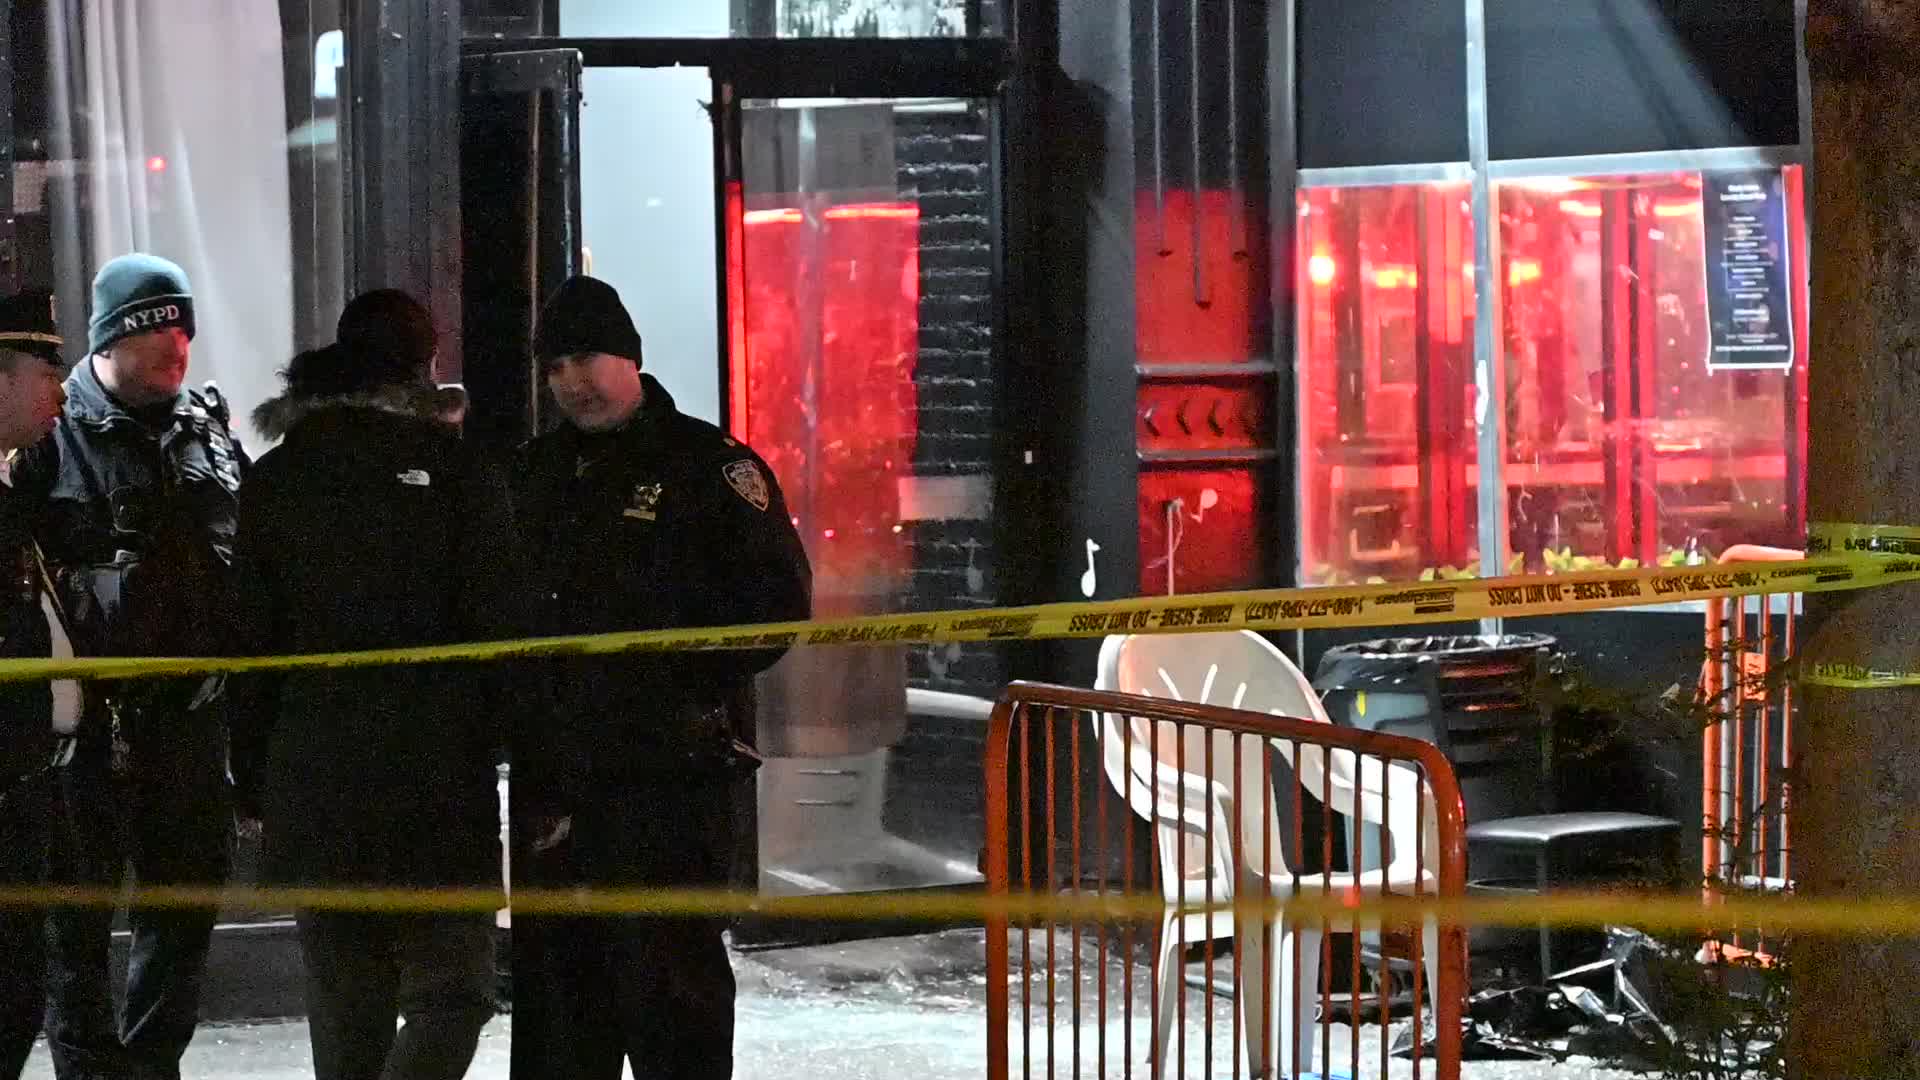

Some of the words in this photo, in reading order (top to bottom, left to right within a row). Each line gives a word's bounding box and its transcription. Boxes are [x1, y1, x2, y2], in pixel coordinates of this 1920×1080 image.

[123, 304, 180, 331] NYPD
[1487, 587, 1523, 607] CROSS
[1525, 585, 1545, 604] NOT
[1546, 584, 1563, 603] DO
[1069, 614, 1108, 633] CROSS
[1132, 610, 1152, 628] DO
